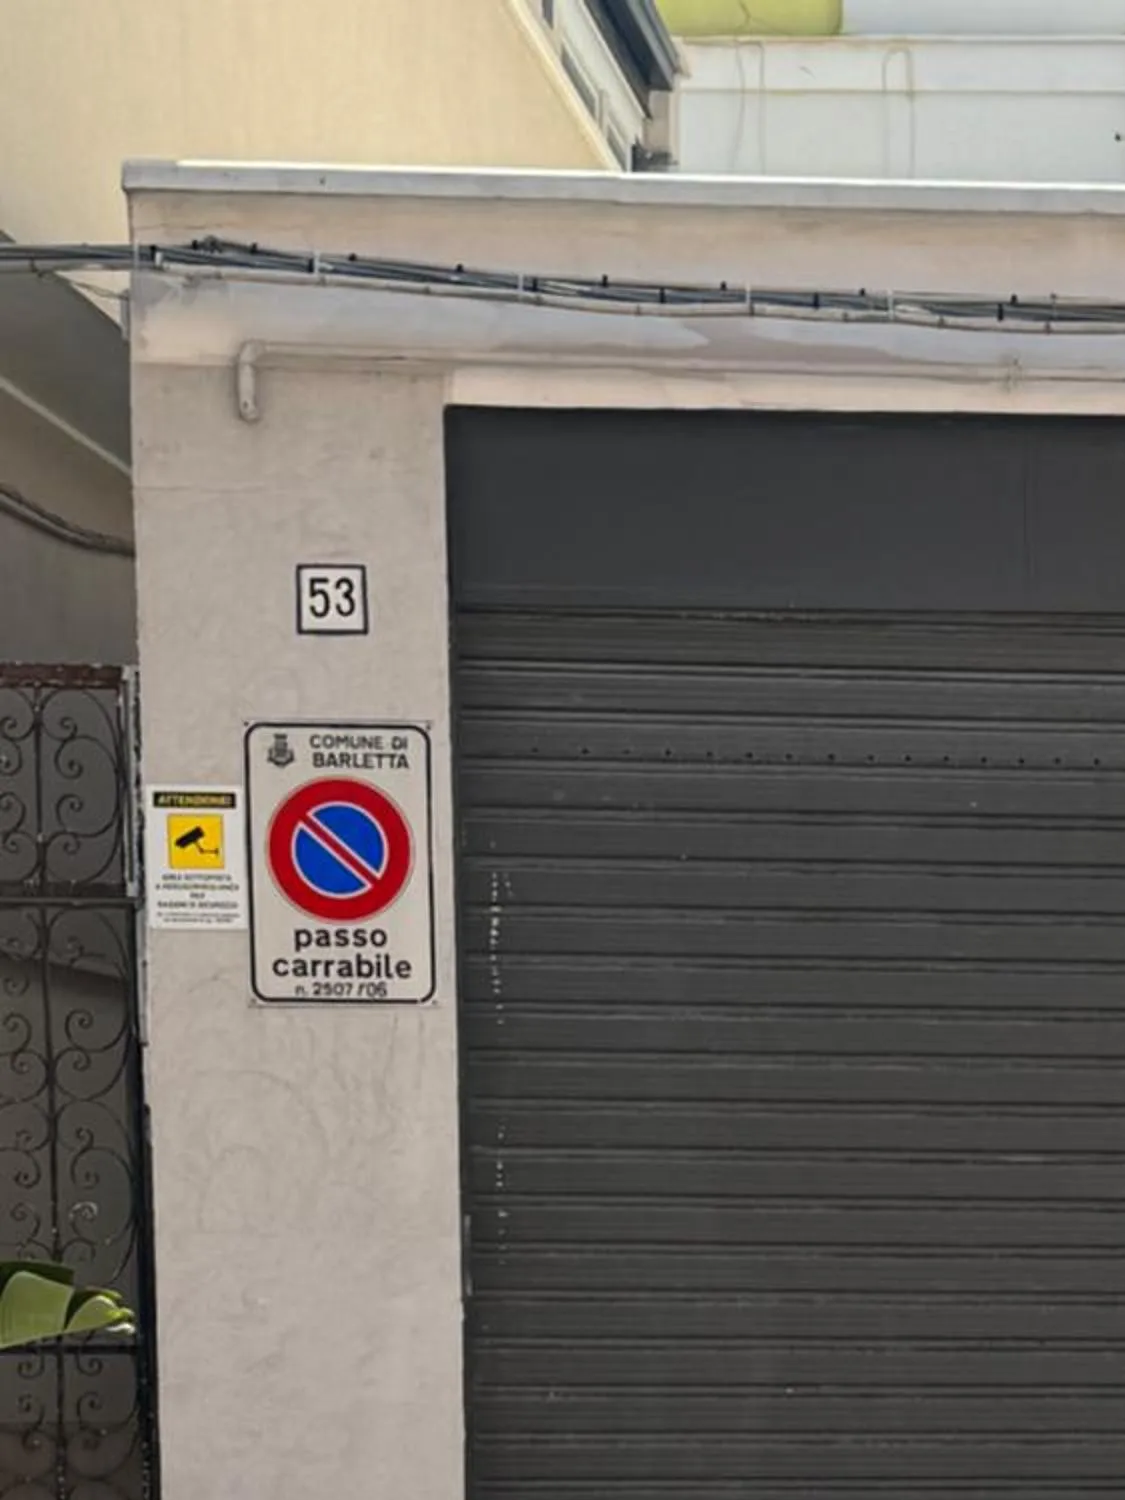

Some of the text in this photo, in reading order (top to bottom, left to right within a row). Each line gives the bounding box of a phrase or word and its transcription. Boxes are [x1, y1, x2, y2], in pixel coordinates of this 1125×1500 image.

[309, 577, 356, 619] 53
[310, 734, 408, 751] COMUNE DI
[312, 751, 409, 769] BARLETTA
[294, 928, 388, 952] passo
[272, 953, 413, 979] carrabile
